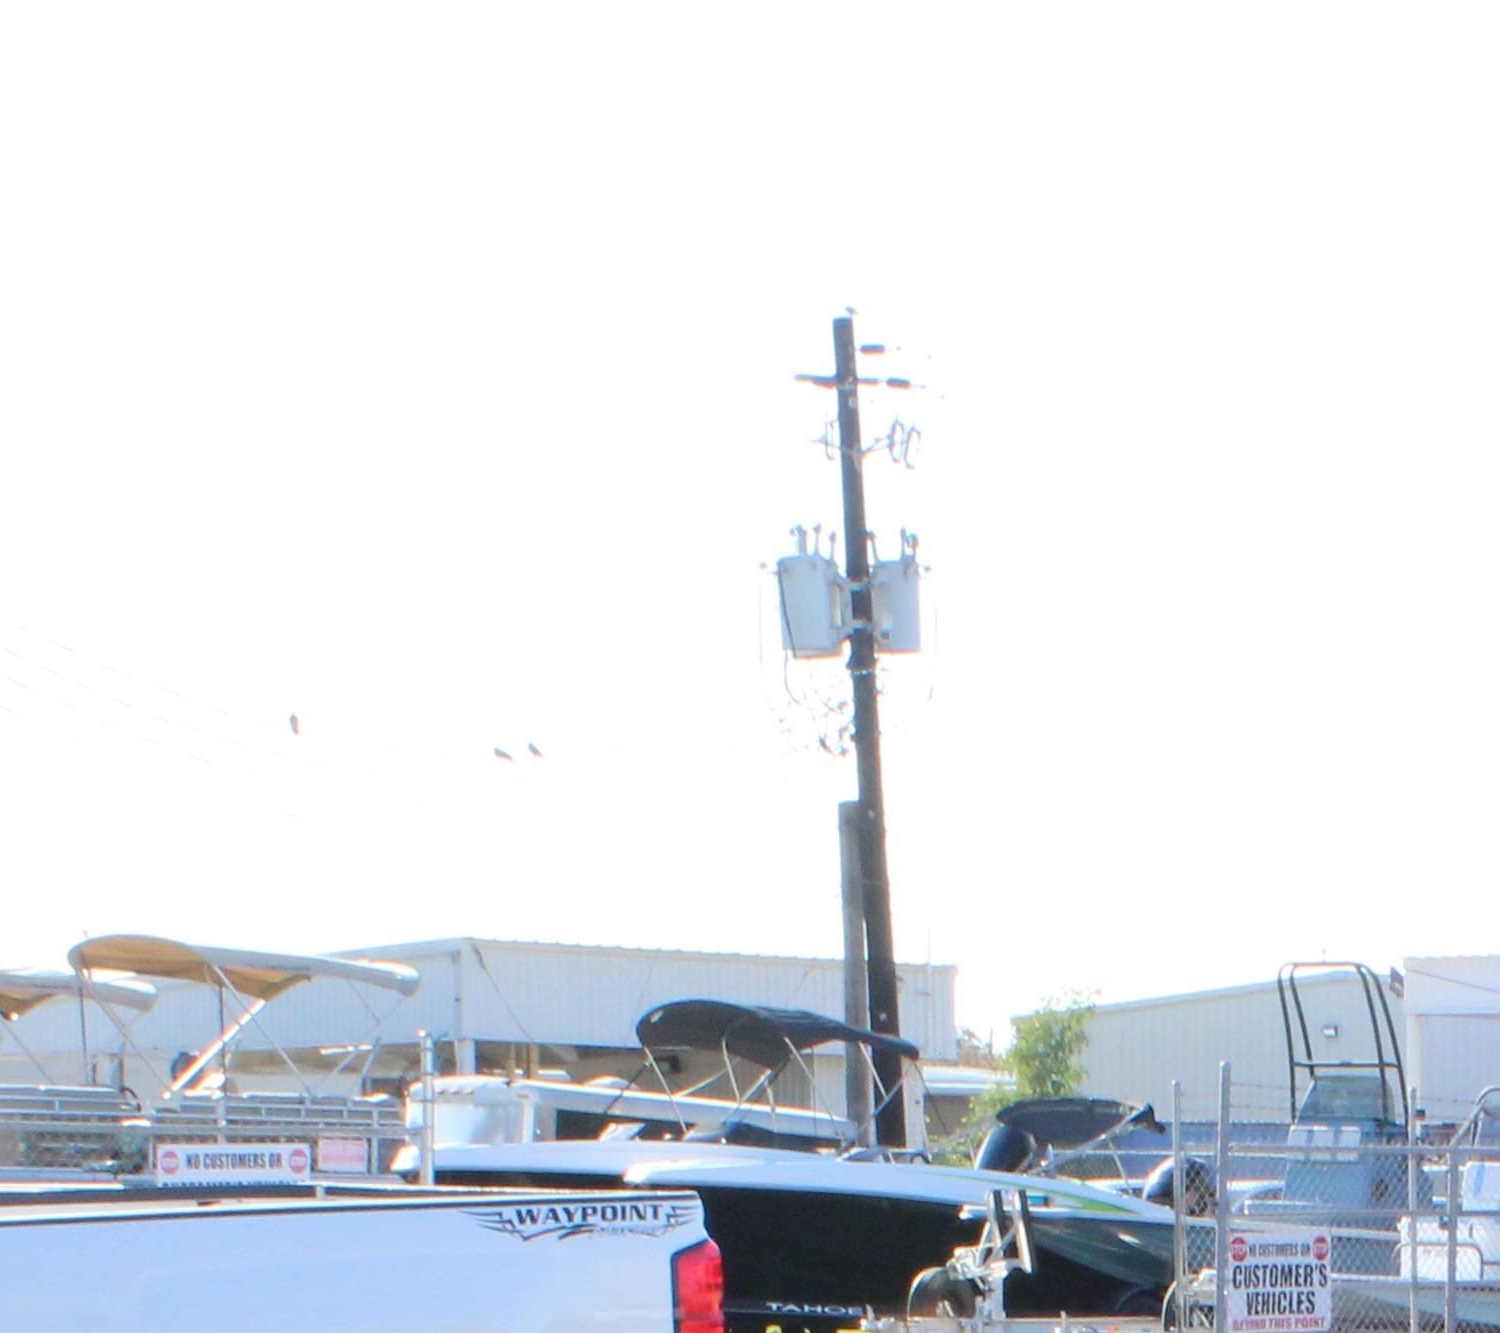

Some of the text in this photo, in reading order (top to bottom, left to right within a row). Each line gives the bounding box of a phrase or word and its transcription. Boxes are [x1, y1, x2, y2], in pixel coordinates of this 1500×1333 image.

[185, 1153, 200, 1170] NO
[203, 1152, 267, 1170] CUSTOMERS
[269, 1152, 283, 1168] OR
[514, 1204, 663, 1225] WAYPOINT
[1259, 1243, 1299, 1257] CUSTOMERS
[1232, 1263, 1328, 1289] CUSTOMER'S
[765, 1301, 863, 1317] TAHOE
[1246, 1291, 1316, 1316] VEHICLES
[1269, 1318, 1292, 1330] THIS
[1295, 1316, 1326, 1329] POINT
